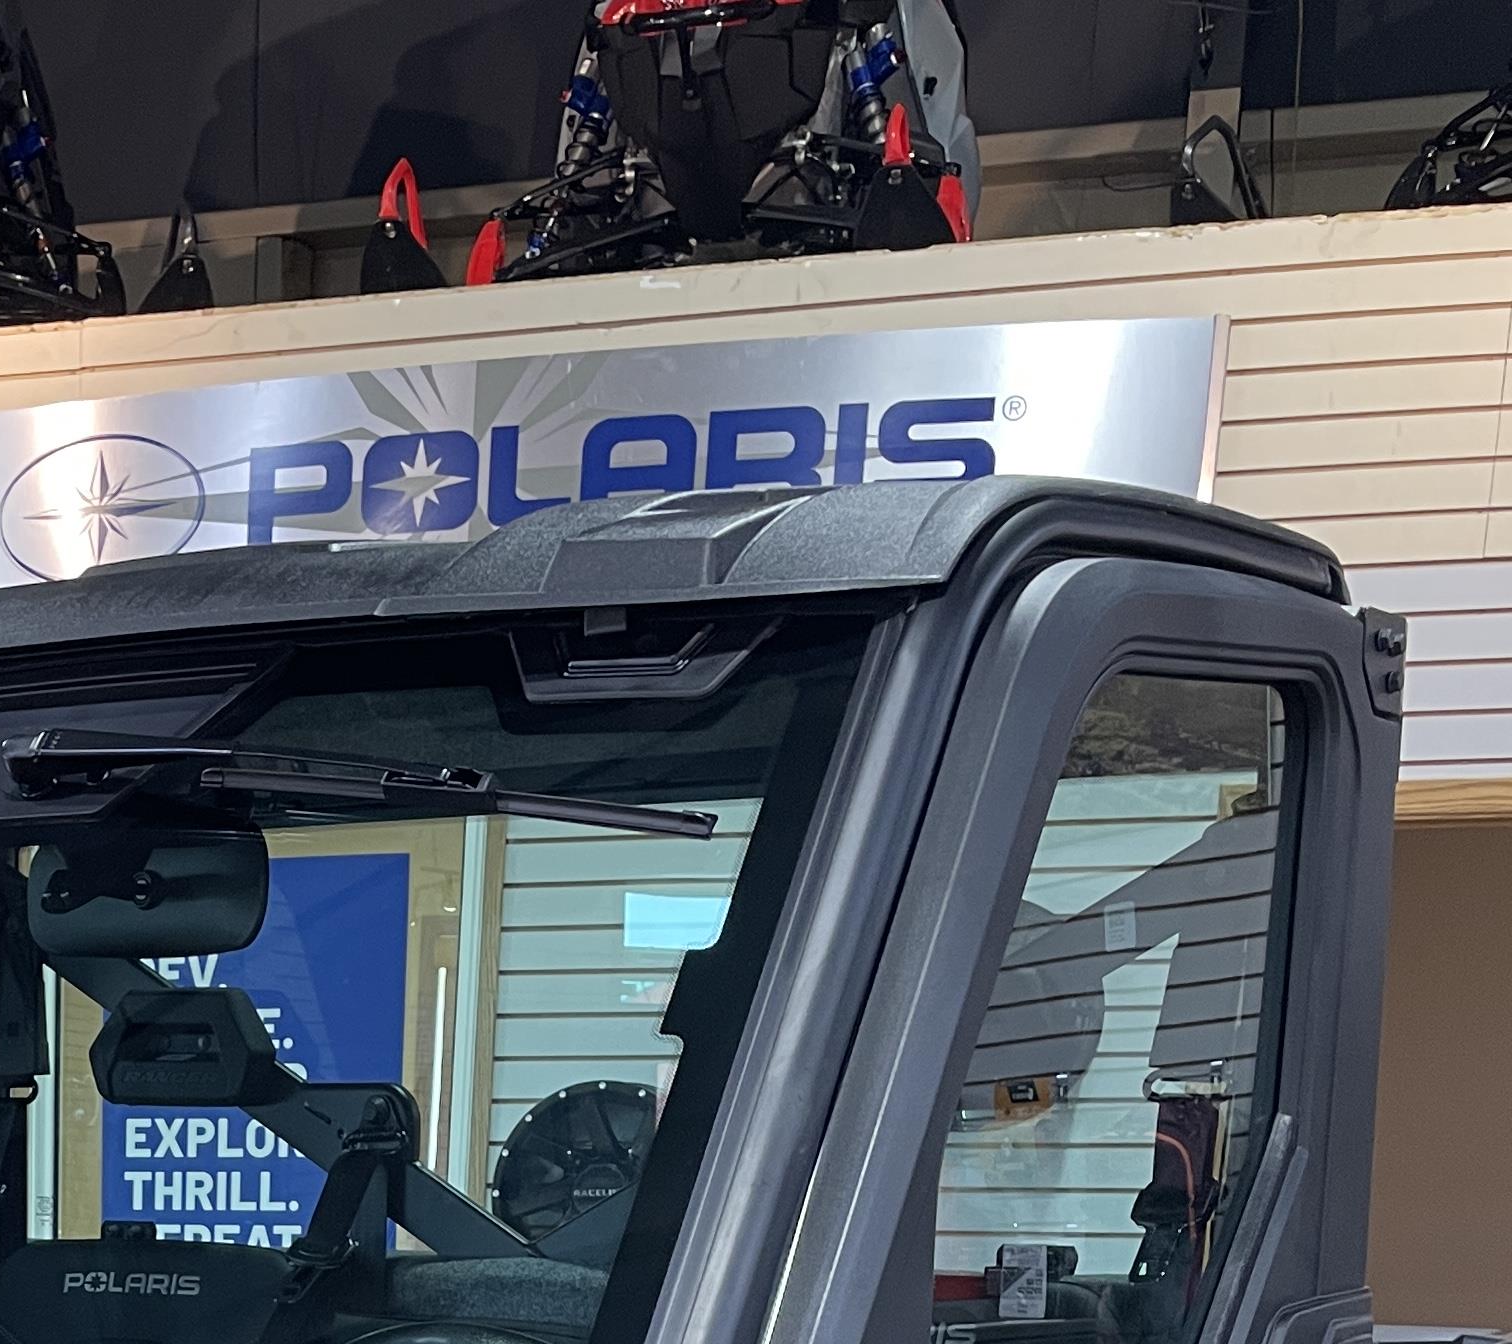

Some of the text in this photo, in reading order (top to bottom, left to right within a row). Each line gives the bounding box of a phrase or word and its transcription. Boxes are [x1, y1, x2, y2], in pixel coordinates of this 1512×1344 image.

[248, 397, 996, 544] POLARIS
[125, 1118, 306, 1158] EXPLO
[124, 1171, 299, 1212] THRILL.
[573, 1189, 617, 1197] RACELI
[63, 1271, 201, 1296] POLARIS
